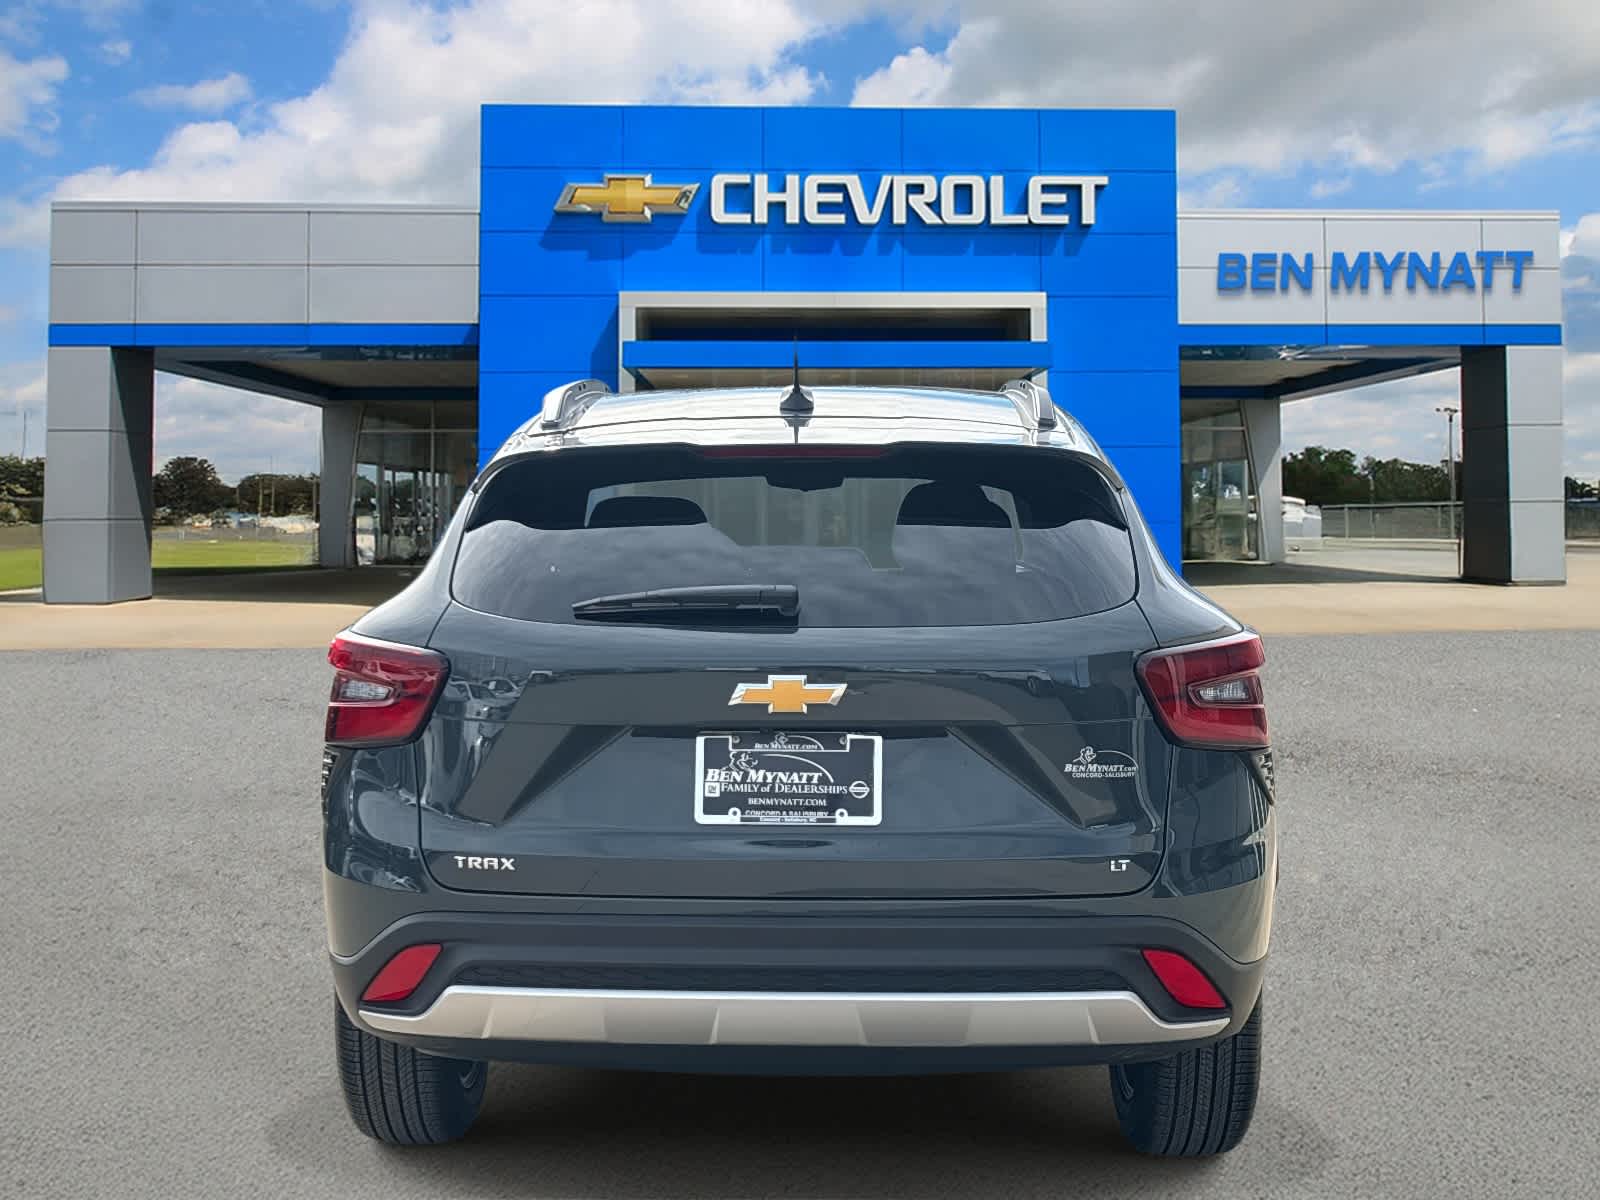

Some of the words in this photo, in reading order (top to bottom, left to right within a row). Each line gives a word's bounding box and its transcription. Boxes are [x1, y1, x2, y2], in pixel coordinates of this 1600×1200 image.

[710, 174, 1109, 225] CHEVROLET
[1216, 252, 1313, 291] BEN
[1330, 250, 1534, 291] MYNATT
[706, 769, 744, 782] BEN
[746, 769, 822, 783] MYNATT
[721, 782, 760, 793] FAMILY
[774, 783, 848, 795] DEALERSHIPS
[748, 797, 827, 807] BENMYNATT.COM
[453, 855, 516, 871] TRAX
[1110, 859, 1131, 872] LT
